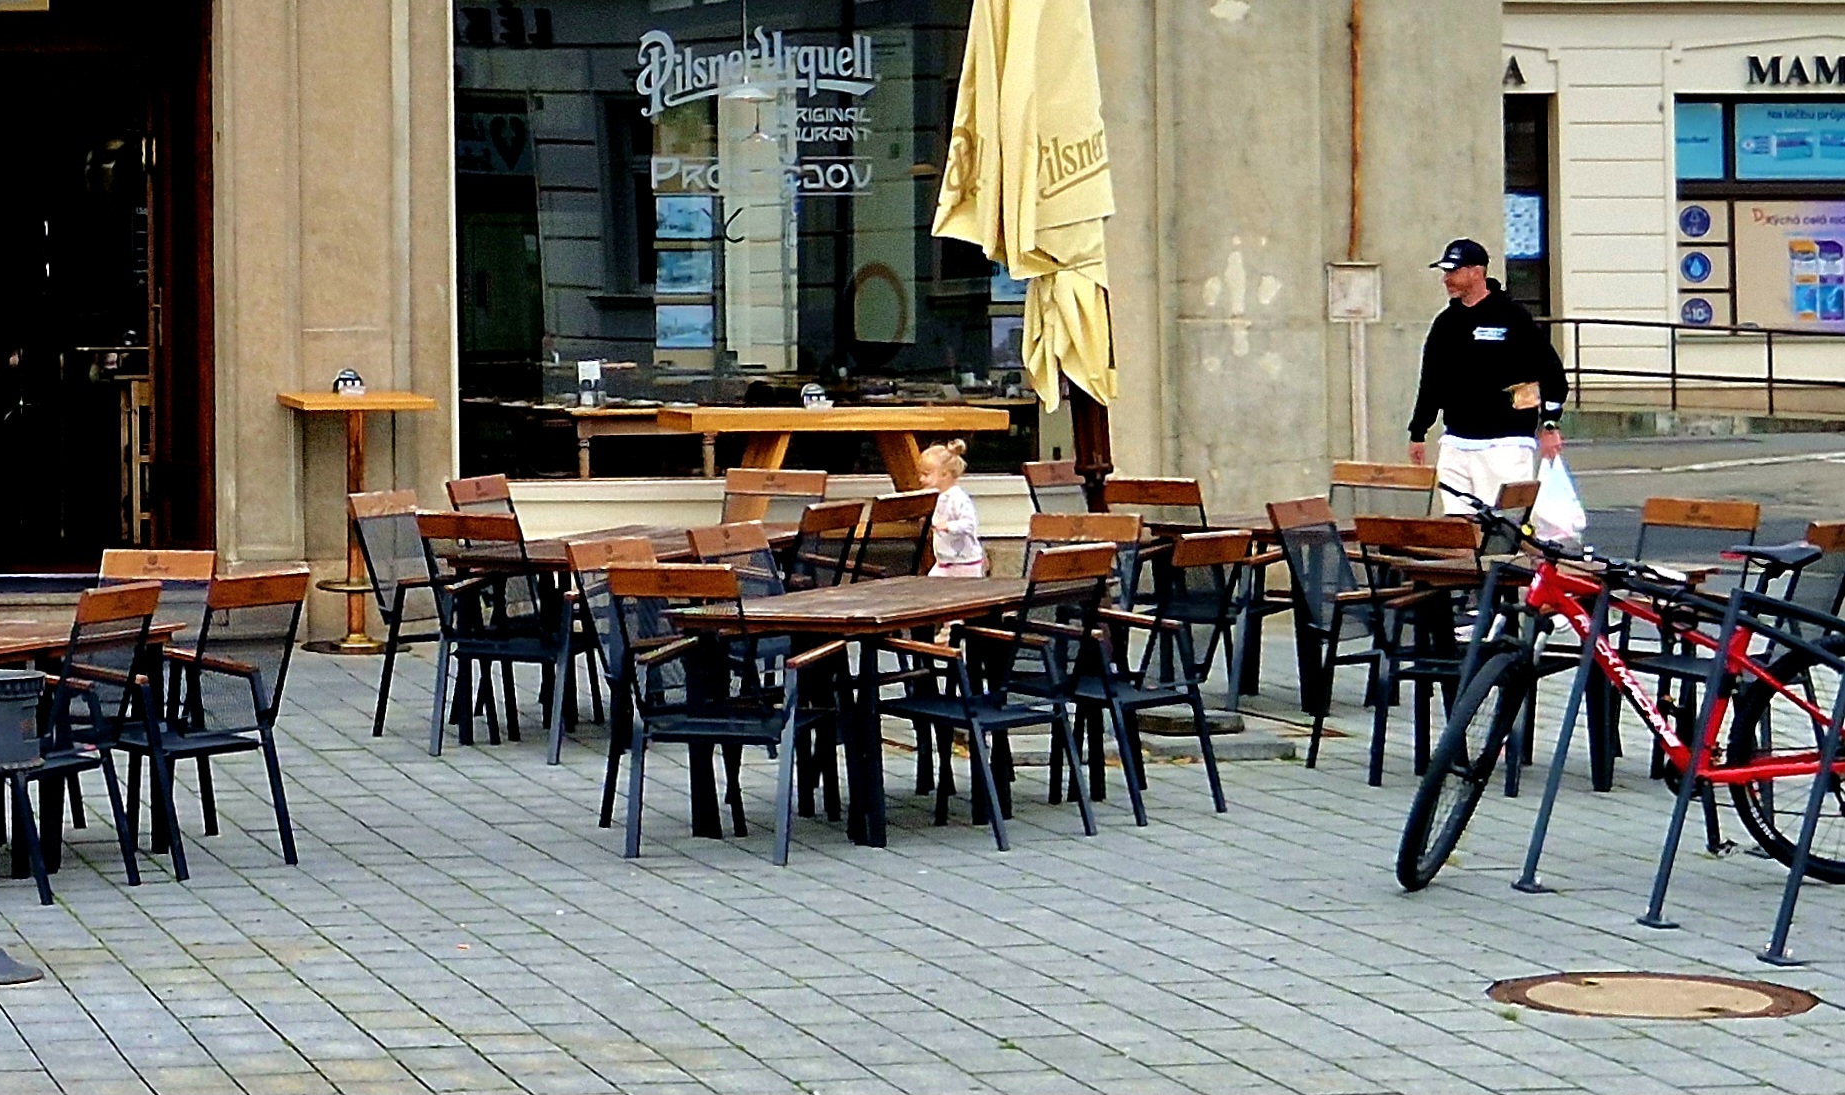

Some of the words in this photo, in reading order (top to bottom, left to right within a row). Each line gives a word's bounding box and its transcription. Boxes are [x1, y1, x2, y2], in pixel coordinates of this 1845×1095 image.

[636, 30, 759, 117] Pilsner
[754, 25, 872, 98] Urquell
[794, 107, 871, 122] RIGINAL
